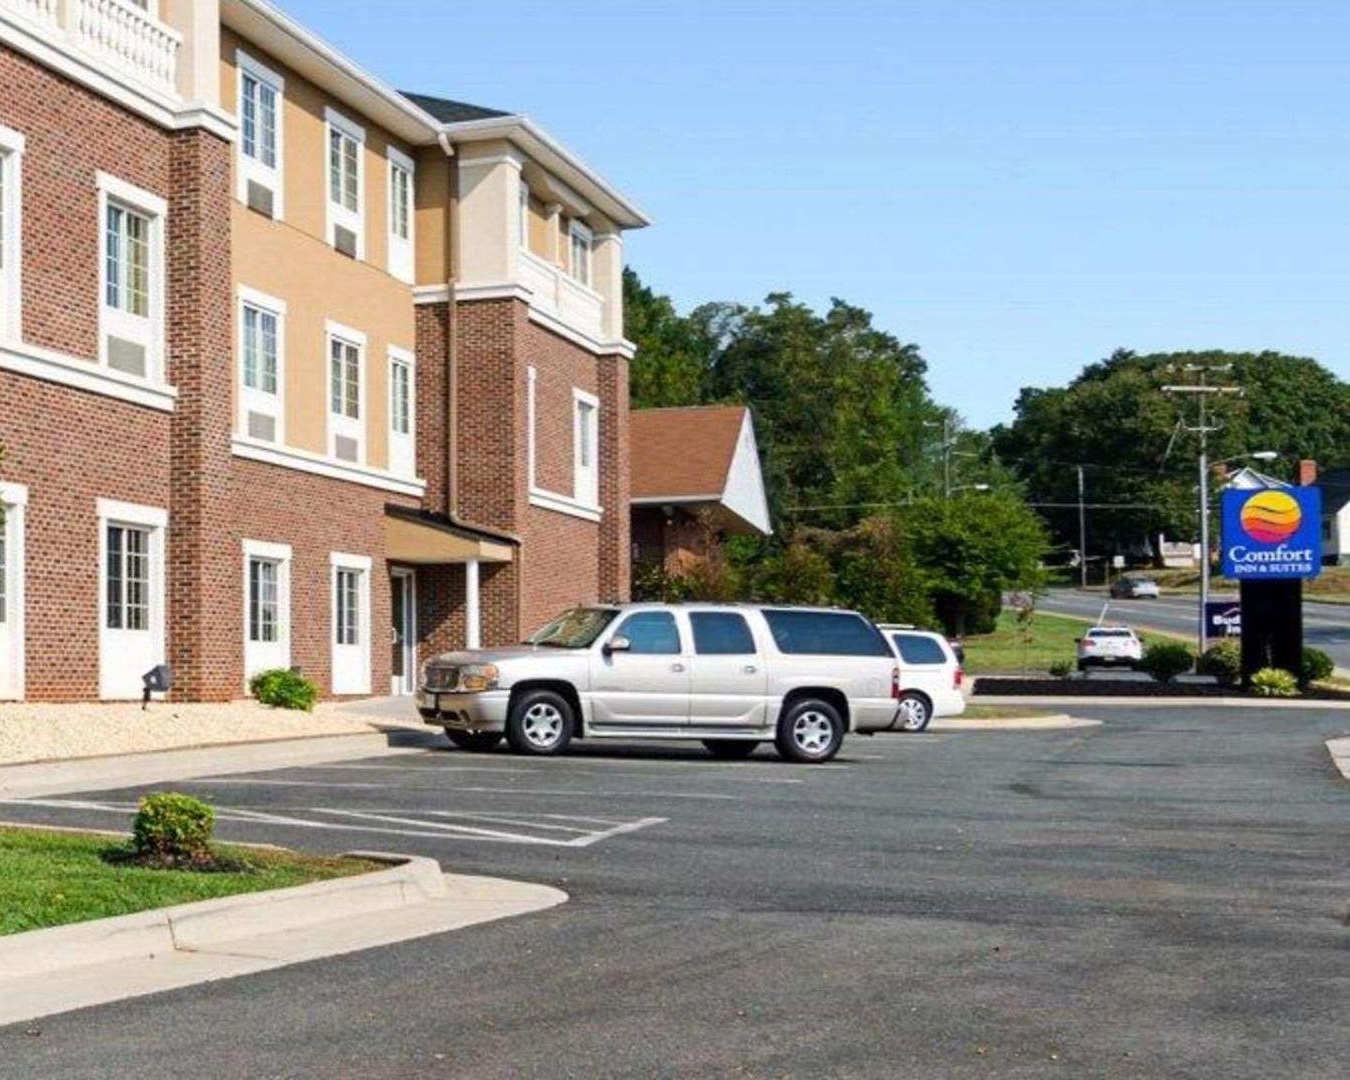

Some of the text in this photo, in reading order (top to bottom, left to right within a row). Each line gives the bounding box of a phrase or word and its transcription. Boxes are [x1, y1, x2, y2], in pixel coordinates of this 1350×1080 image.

[1229, 543, 1313, 563] Comfort
[1234, 563, 1311, 573] INN & SUITES
[1212, 614, 1241, 625] Bud
